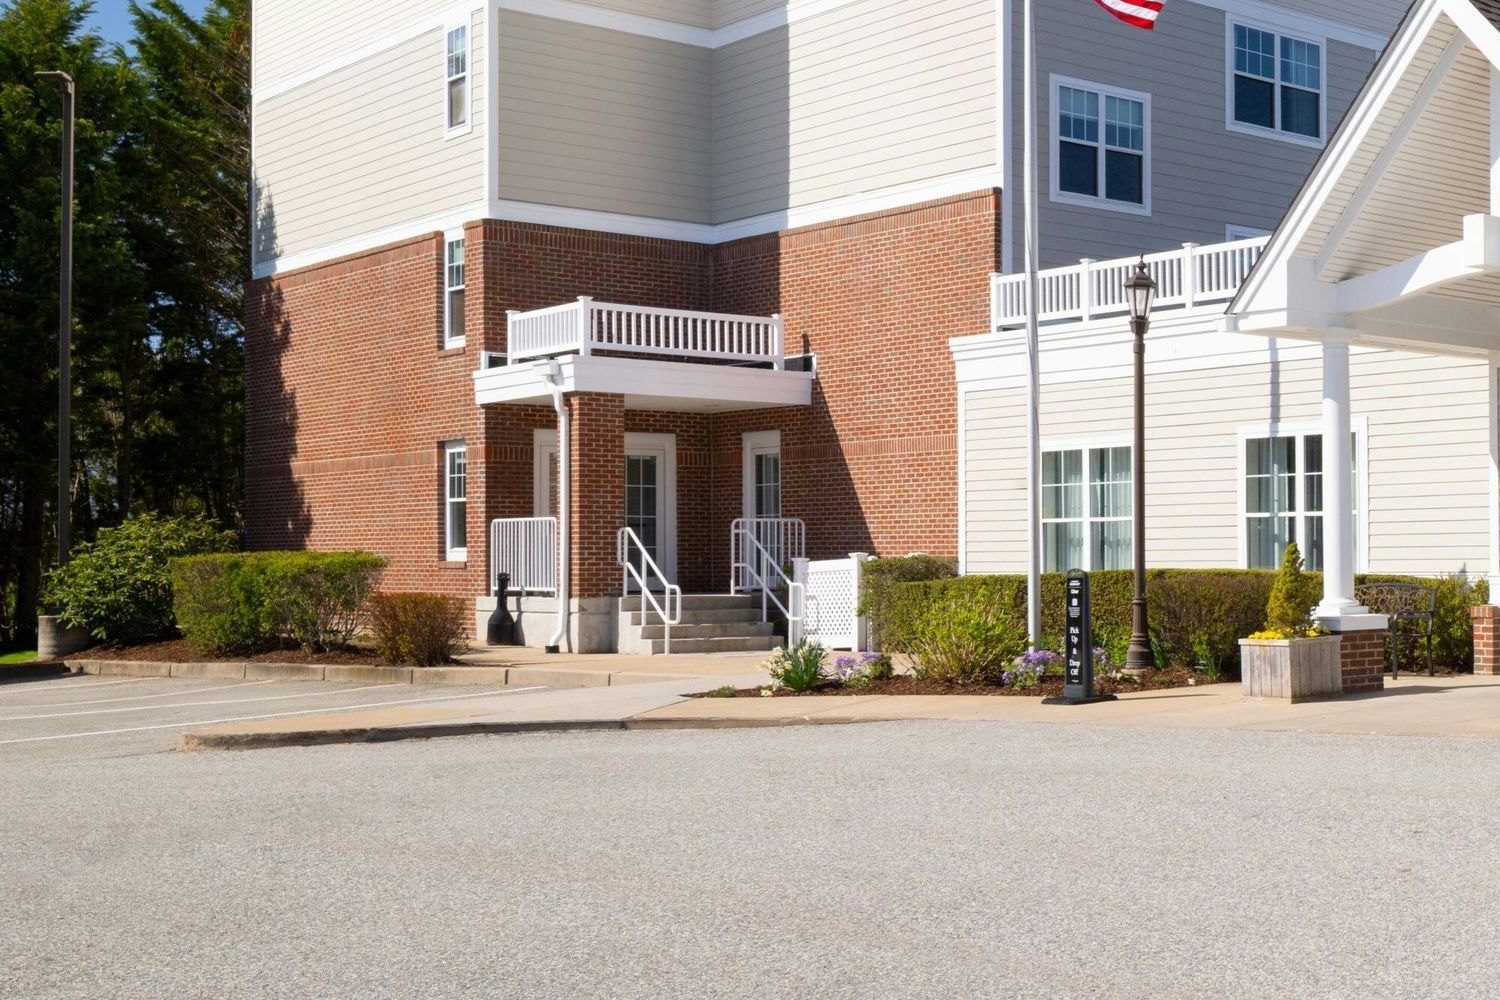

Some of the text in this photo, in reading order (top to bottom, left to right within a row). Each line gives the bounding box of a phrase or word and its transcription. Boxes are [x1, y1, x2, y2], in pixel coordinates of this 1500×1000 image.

[1069, 626, 1079, 634] Pick
[1071, 635, 1079, 644] Up
[1069, 659, 1080, 668] Drop
[1070, 668, 1079, 676] Off
